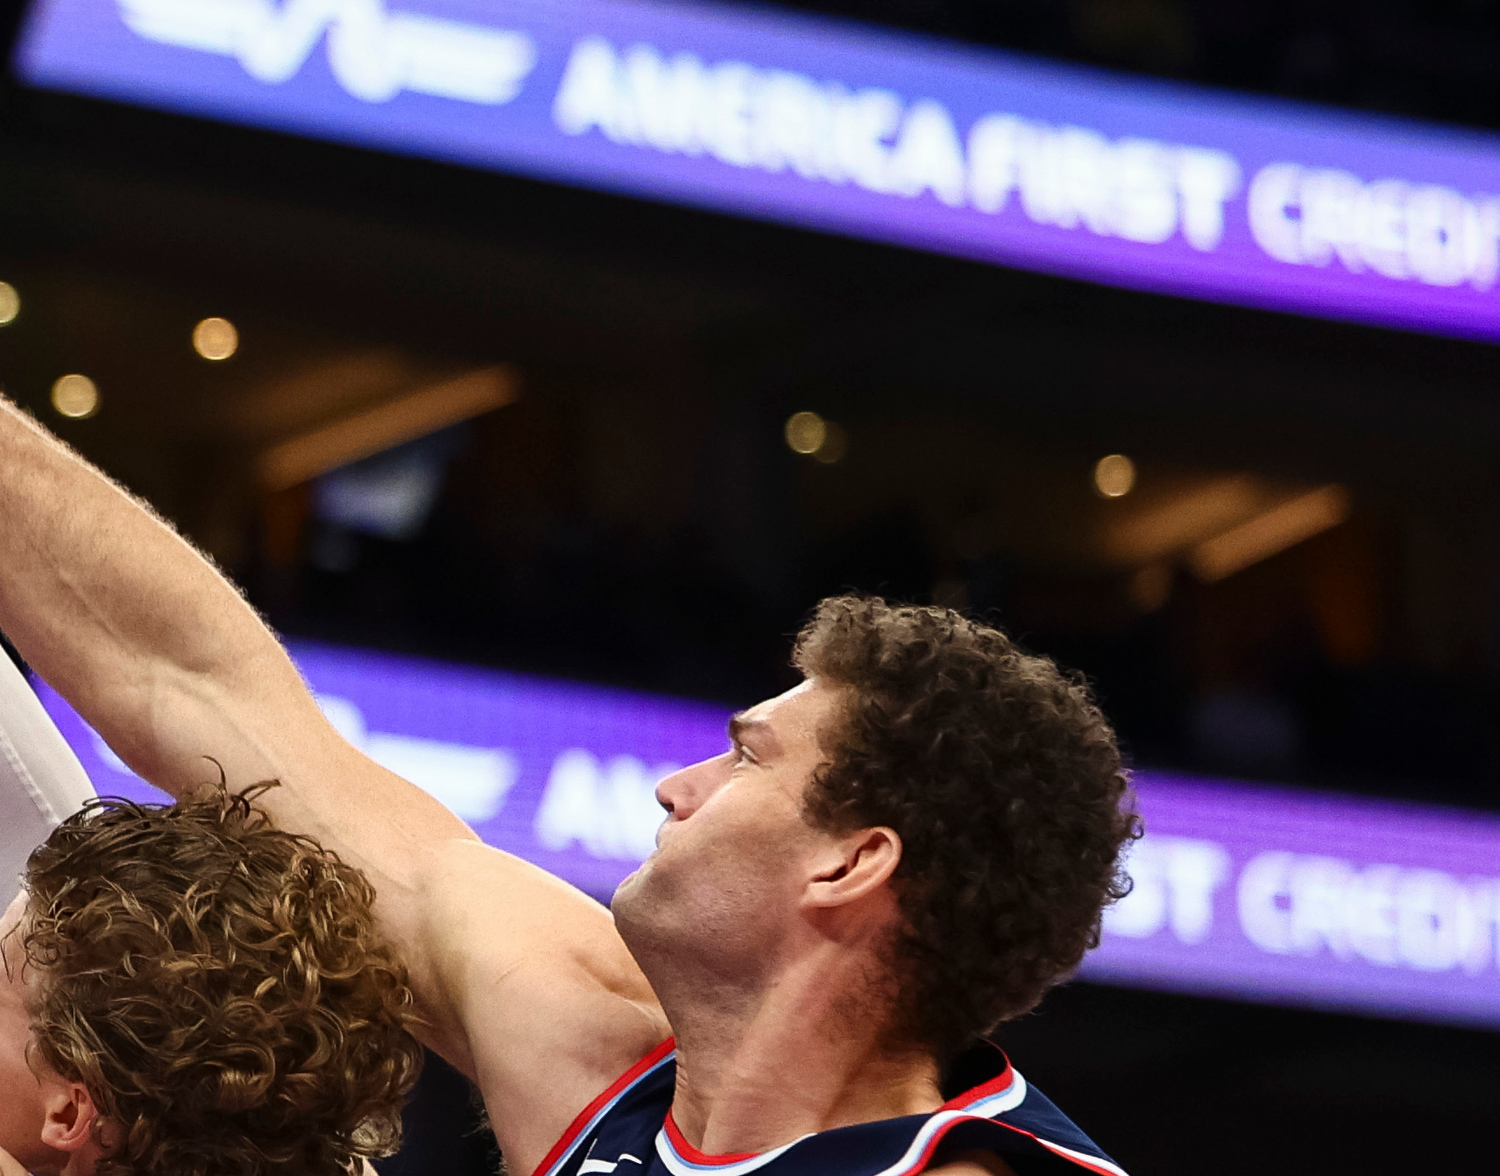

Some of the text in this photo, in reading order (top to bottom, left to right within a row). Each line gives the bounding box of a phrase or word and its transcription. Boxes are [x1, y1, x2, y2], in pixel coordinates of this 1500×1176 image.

[967, 112, 1242, 252] FIRST
[1248, 162, 1500, 292] CREDI
[1238, 850, 1500, 978] CREDI
